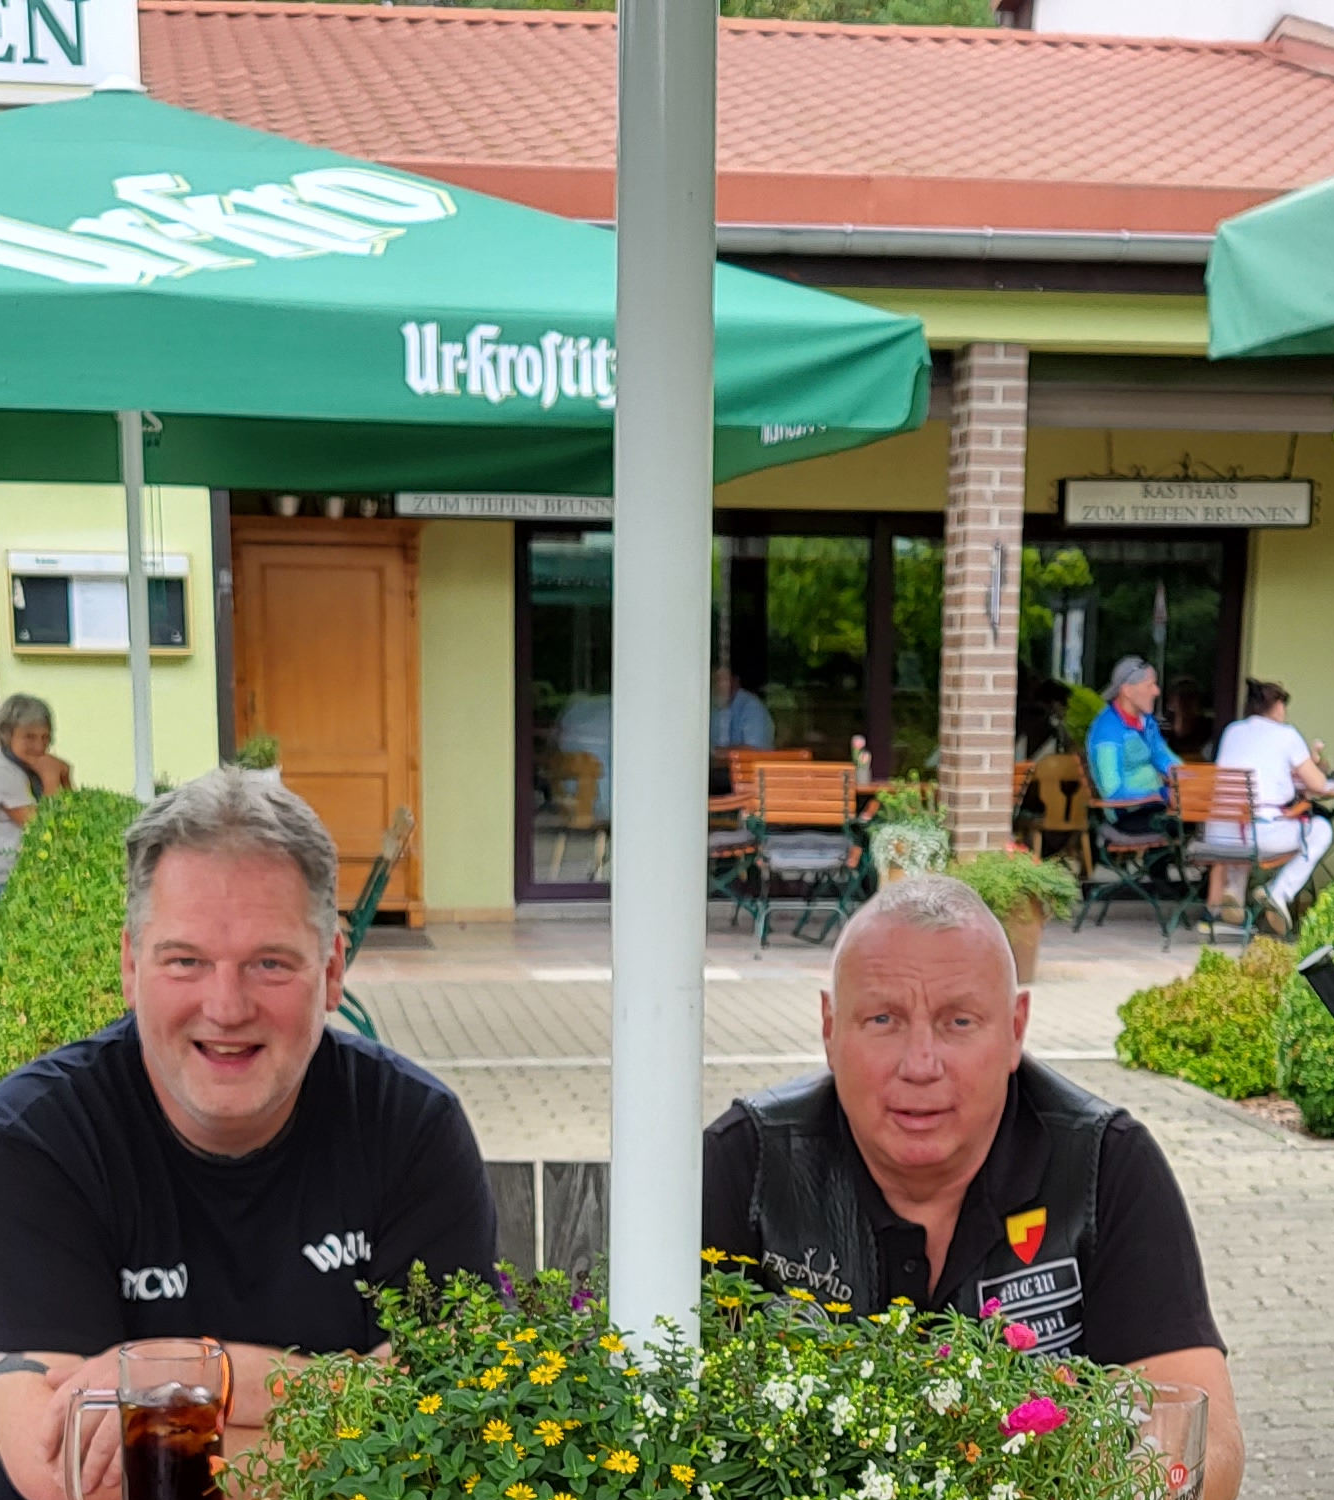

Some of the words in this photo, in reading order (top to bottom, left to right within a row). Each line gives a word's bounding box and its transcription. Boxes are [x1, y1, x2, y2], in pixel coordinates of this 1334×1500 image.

[400, 321, 616, 411] Ur-Krostit
[413, 496, 461, 513] ZUM
[543, 499, 615, 516] BRUNN
[1081, 505, 1125, 521] ZUM
[1131, 505, 1198, 522] TIEFEN
[1203, 506, 1297, 523] BRUNNEN
